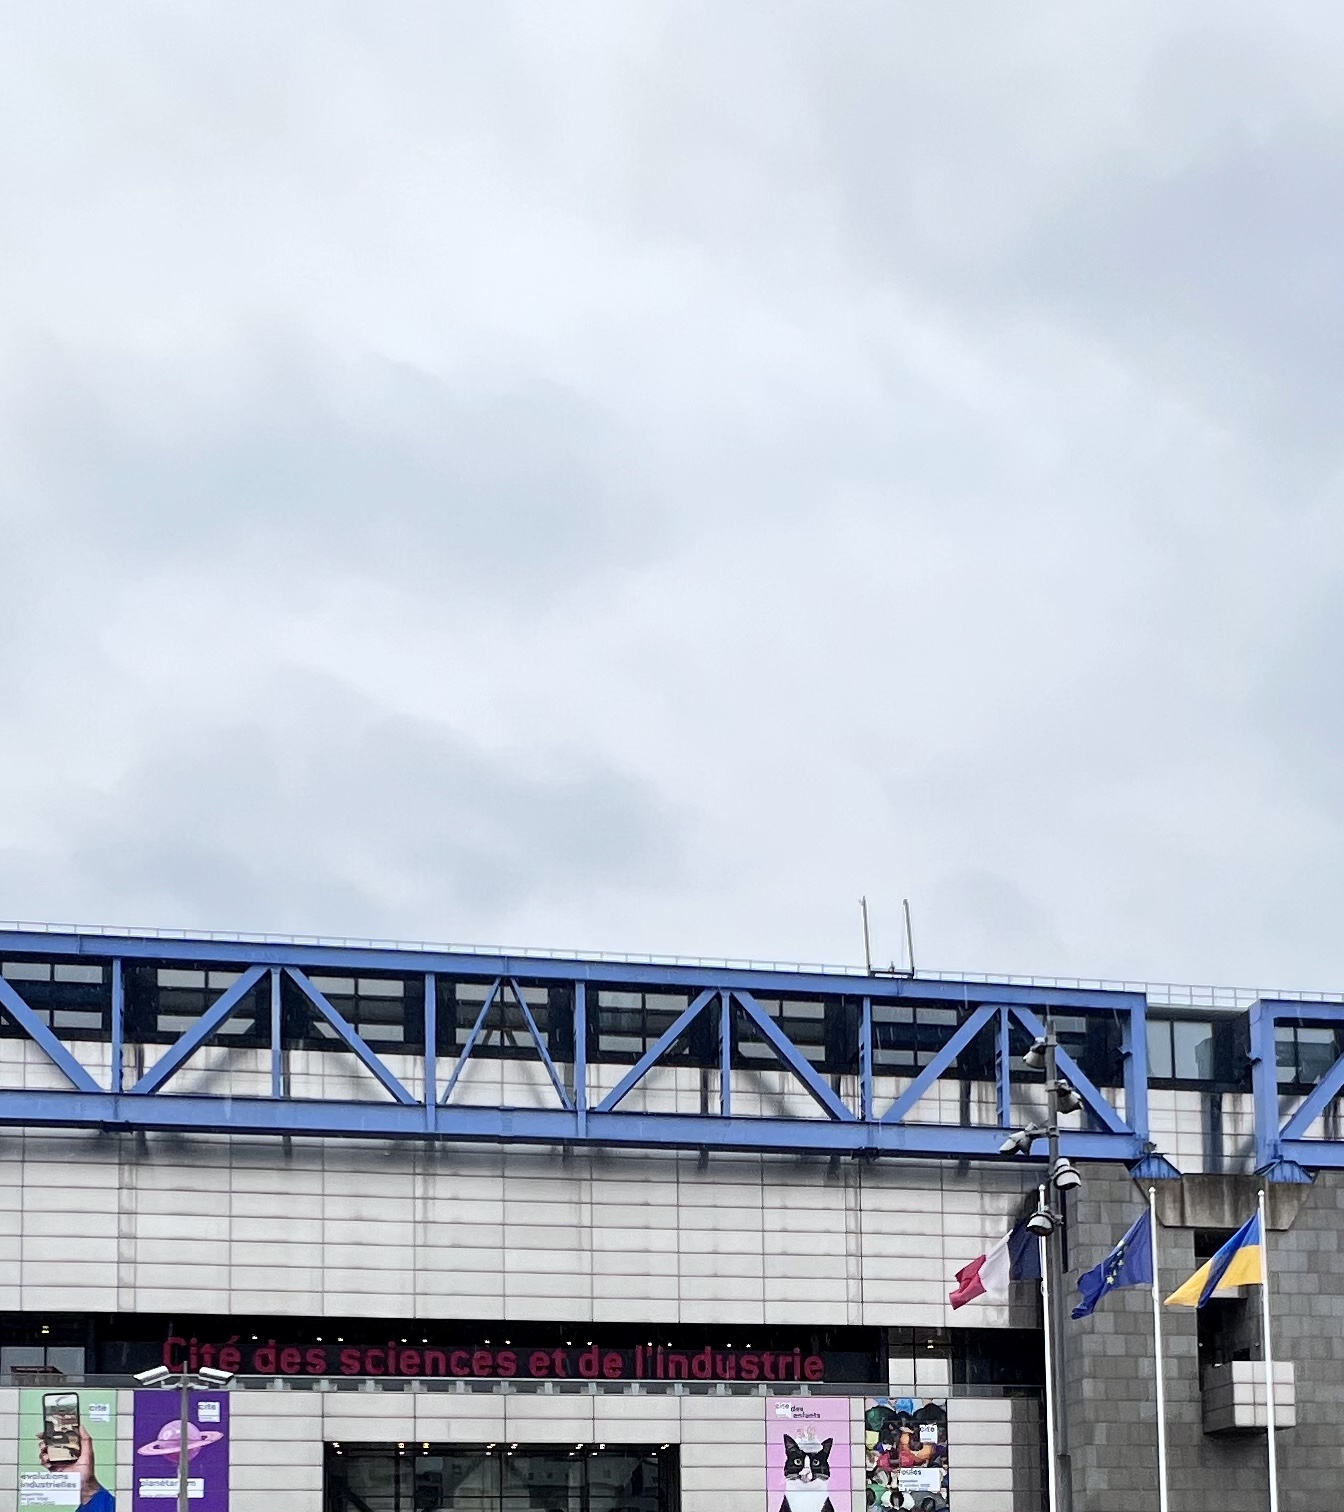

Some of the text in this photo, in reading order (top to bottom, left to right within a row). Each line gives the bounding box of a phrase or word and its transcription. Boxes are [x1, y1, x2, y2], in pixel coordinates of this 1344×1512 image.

[163, 1336, 825, 1380] Cité des sciences et de l'industrie
